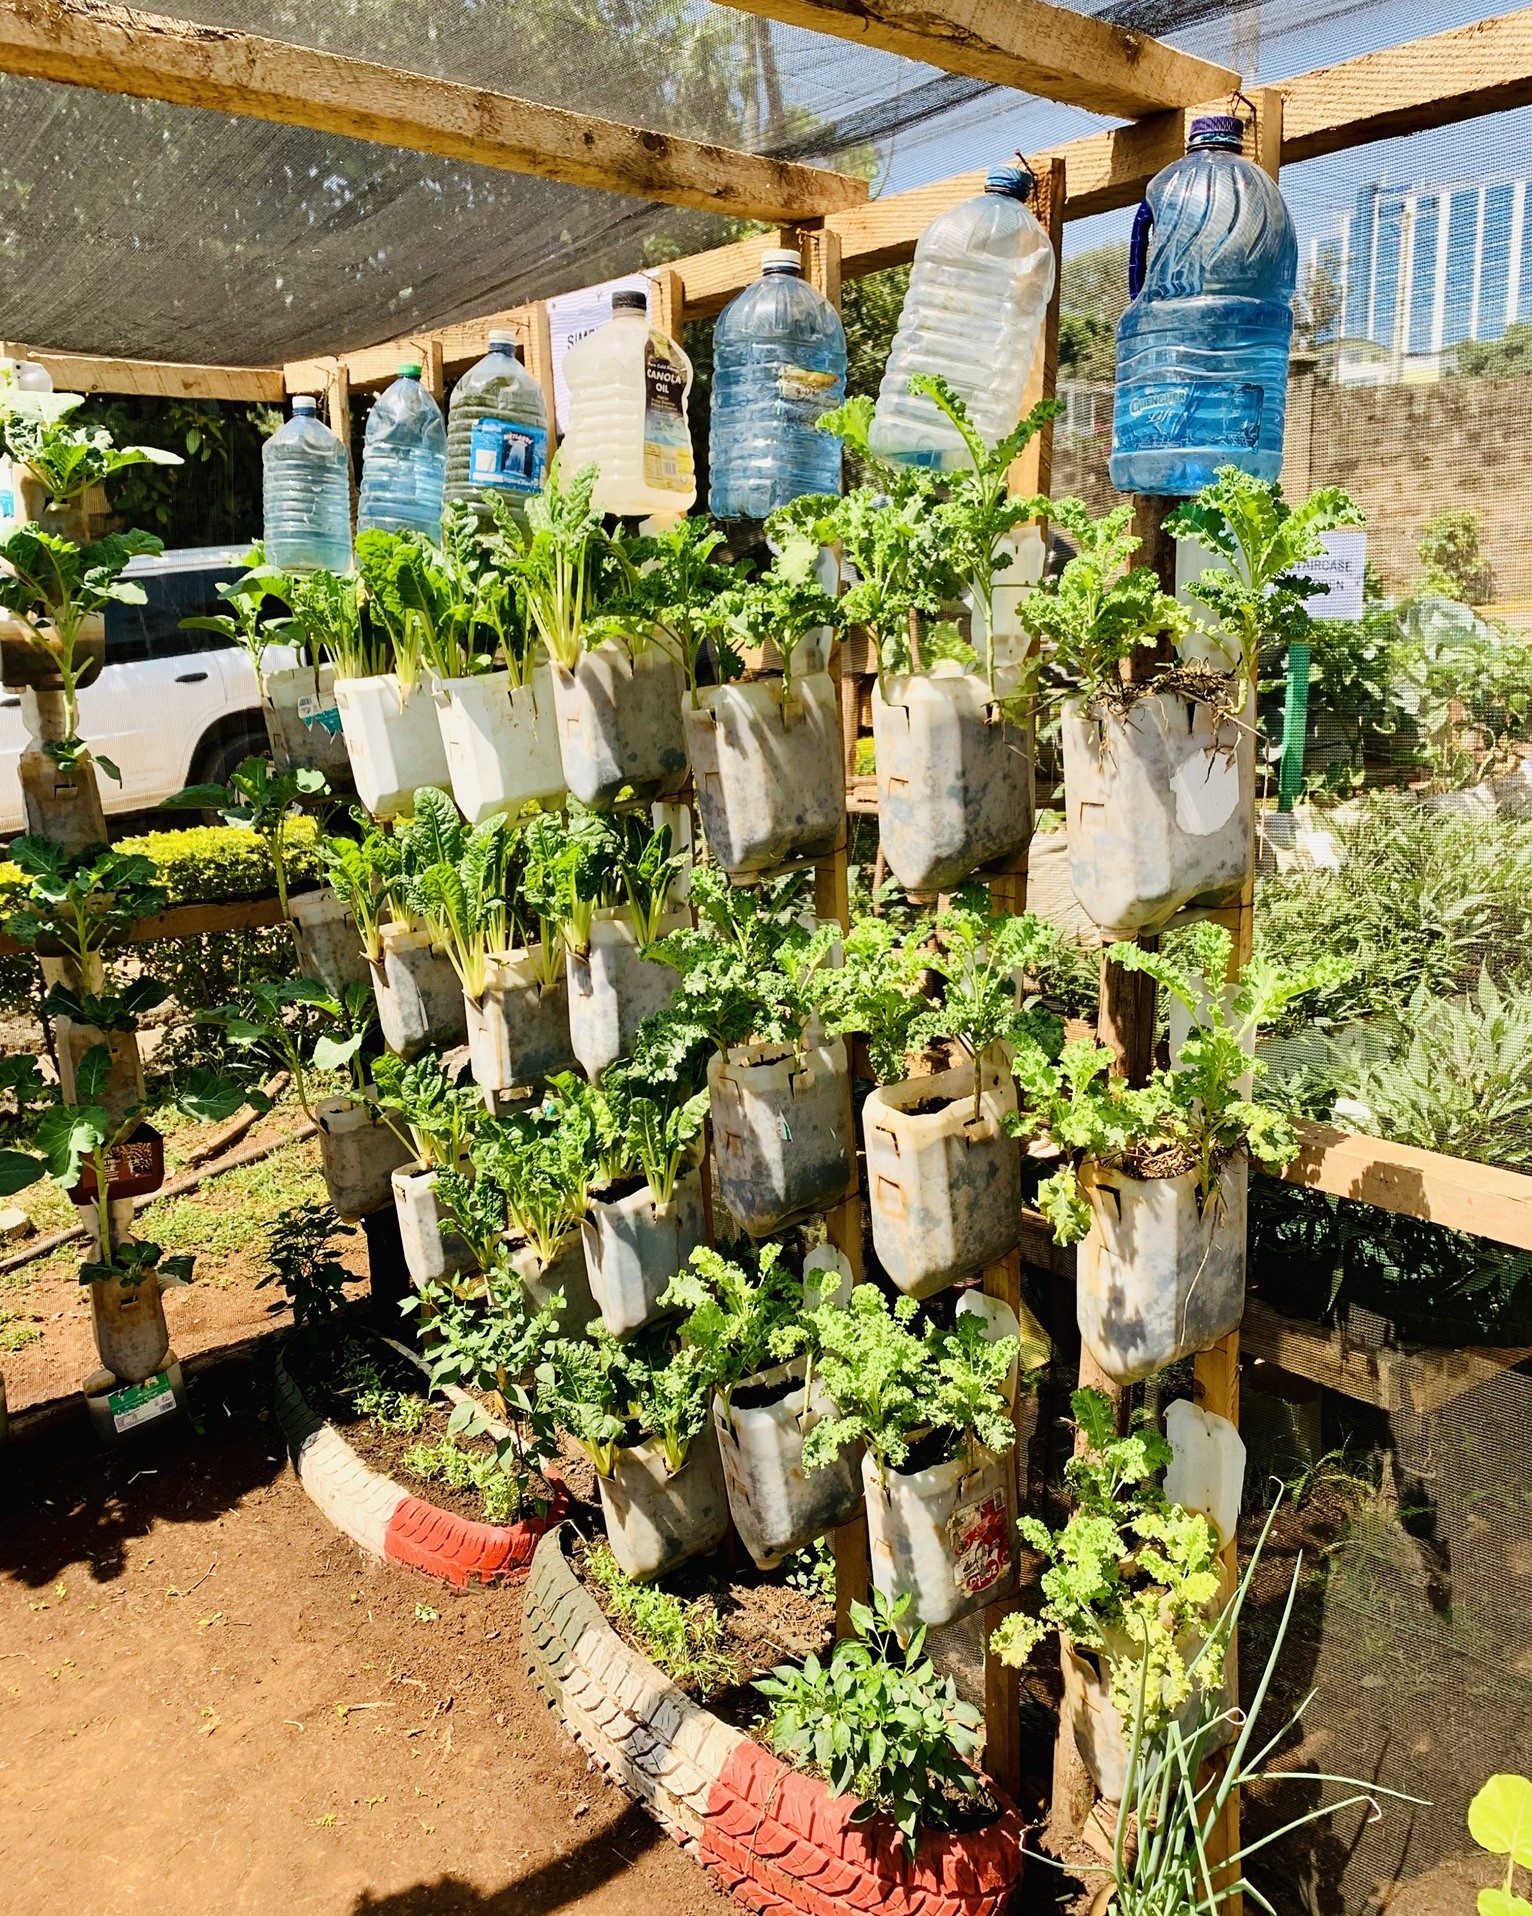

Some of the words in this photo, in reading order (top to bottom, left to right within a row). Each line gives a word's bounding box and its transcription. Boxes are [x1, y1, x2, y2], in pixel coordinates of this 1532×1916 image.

[647, 368, 682, 385] CANOLA
[655, 382, 670, 394] OIL
[1130, 390, 1186, 414] QUENCHER
